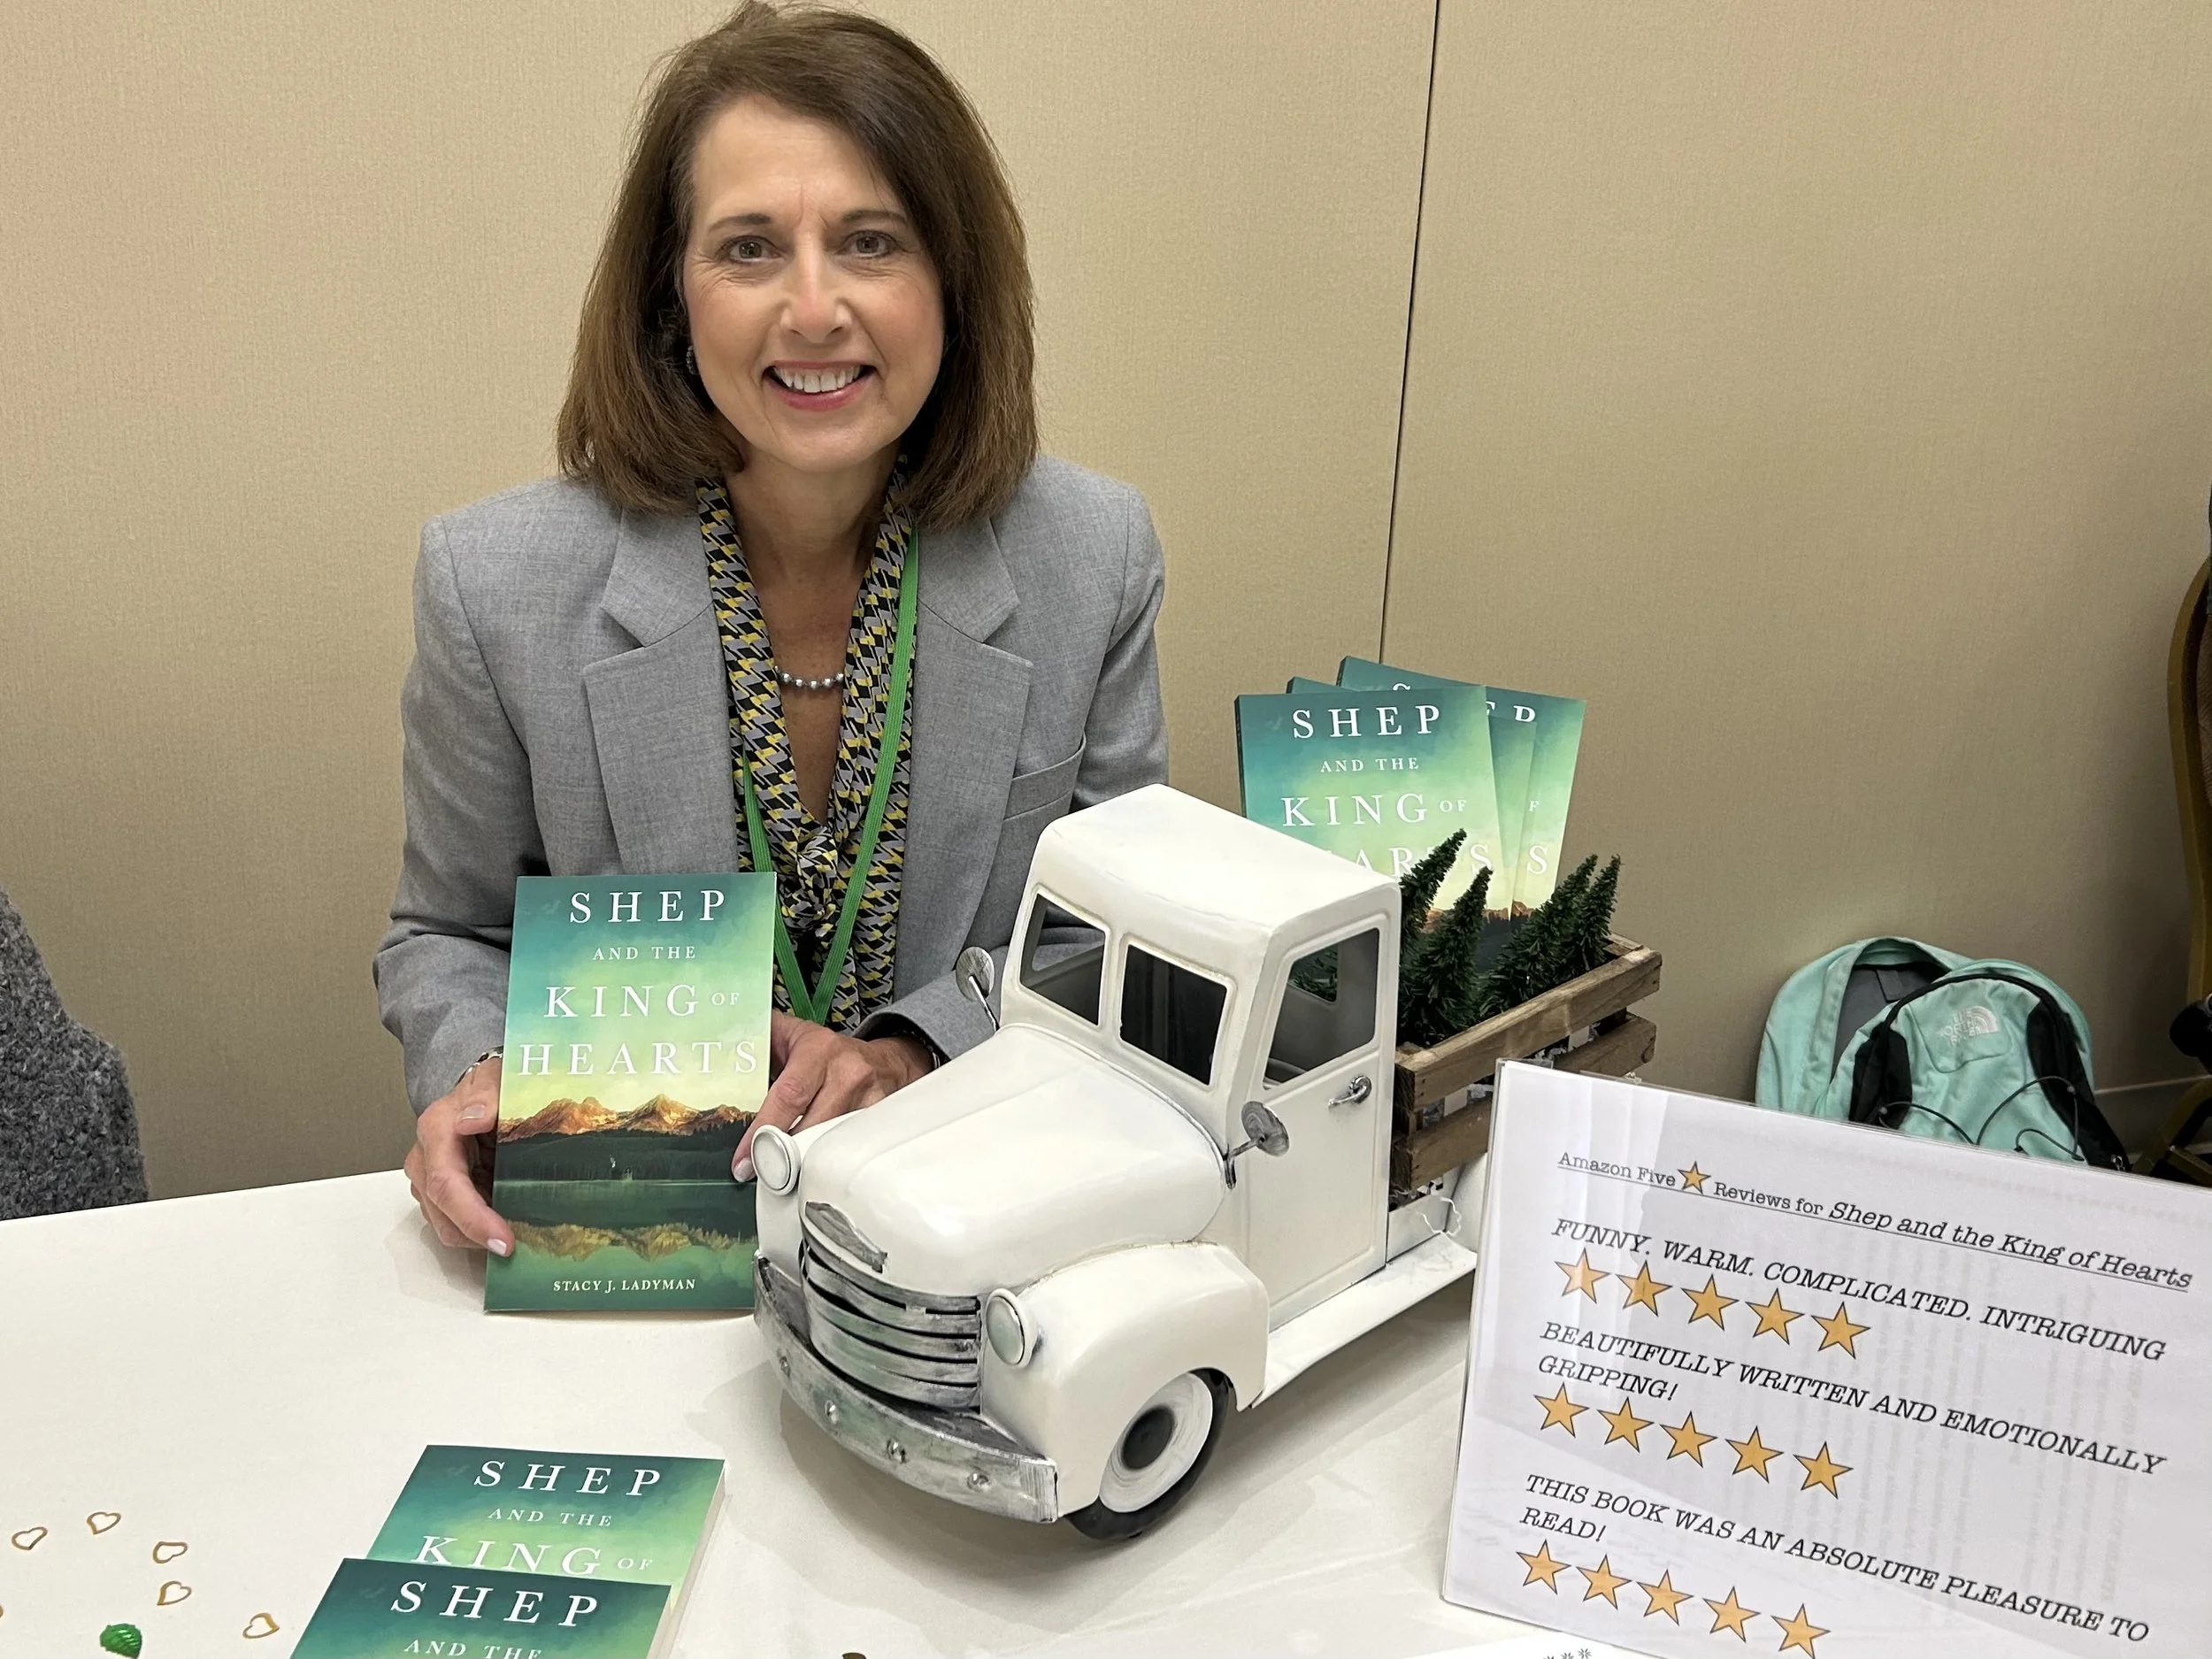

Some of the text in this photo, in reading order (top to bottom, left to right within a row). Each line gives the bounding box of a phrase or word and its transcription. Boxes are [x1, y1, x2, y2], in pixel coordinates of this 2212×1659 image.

[1292, 704, 1440, 739] SHEP
[1320, 757, 1419, 773] AND THE
[1280, 793, 1467, 827] KING OF
[569, 889, 726, 924] SHEP
[593, 945, 696, 961] AND THE
[543, 984, 741, 1018] KING OF
[518, 1041, 757, 1077] HEARTS
[1557, 1152, 2193, 1288] Amazon Five Reviews for Shep and the King of Hearts
[553, 1279, 696, 1294] STACY J. LADYMAN
[1551, 1218, 1652, 1255] FUNNY.
[1663, 1240, 1754, 1276] WARM.
[1764, 1262, 1971, 1321] COMPLICATED.
[1979, 1306, 2167, 1362] INTRIGUING
[1539, 1355, 1679, 1402] GRIPPING!
[1540, 1321, 2168, 1475] BEAUTIFULLY WRITTEN AND EMOTIONALLY
[473, 1460, 661, 1497] SHEP
[488, 1508, 612, 1527] AND THE
[1519, 1507, 1607, 1543] READ!
[411, 1535, 653, 1576] KING OF
[1525, 1474, 2150, 1642] THIS BOOK WAS AN ABSOLUTE PLEASURE TO
[391, 1580, 598, 1628] SHEP
[403, 1639, 542, 1659] AND THE
